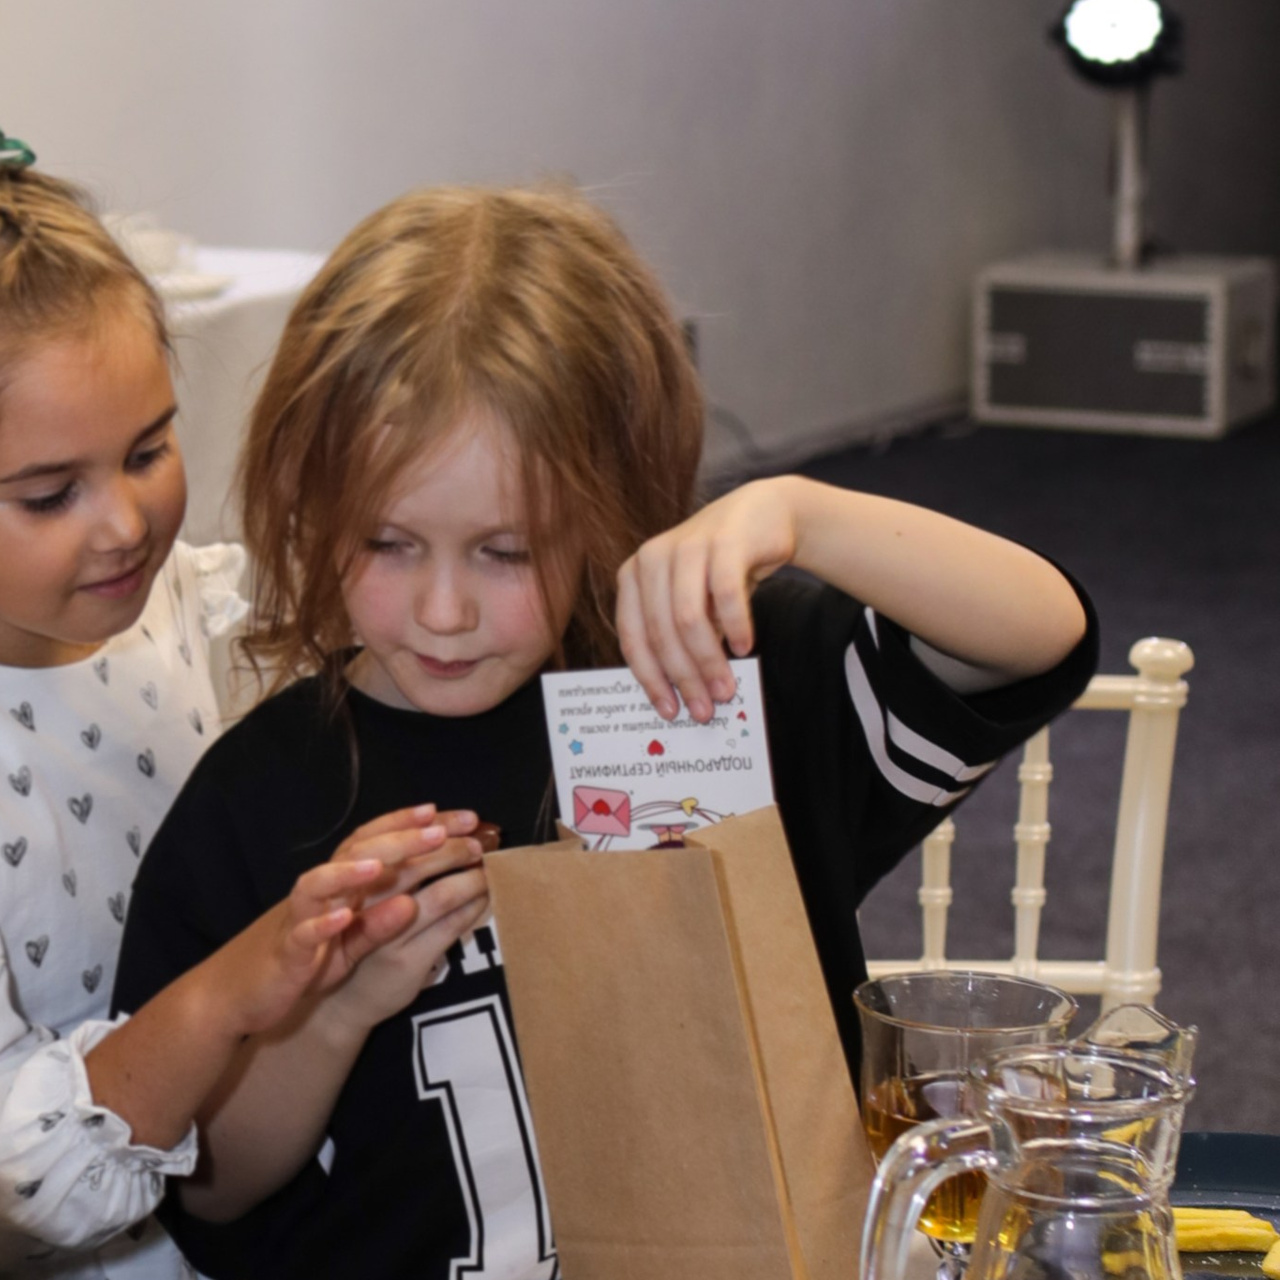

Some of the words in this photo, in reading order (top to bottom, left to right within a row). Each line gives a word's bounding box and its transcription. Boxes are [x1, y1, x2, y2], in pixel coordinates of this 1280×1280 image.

[558, 681, 632, 697] вкусняшками
[560, 702, 593, 716] время
[596, 704, 628, 719] любое
[630, 703, 636, 712] в
[579, 723, 611, 734] гости
[613, 723, 619, 732] в
[622, 716, 664, 733] прийти
[569, 762, 652, 779] СЕРТИФИКАТ
[655, 754, 753, 778] ПОДАРОЧНЫЙ
